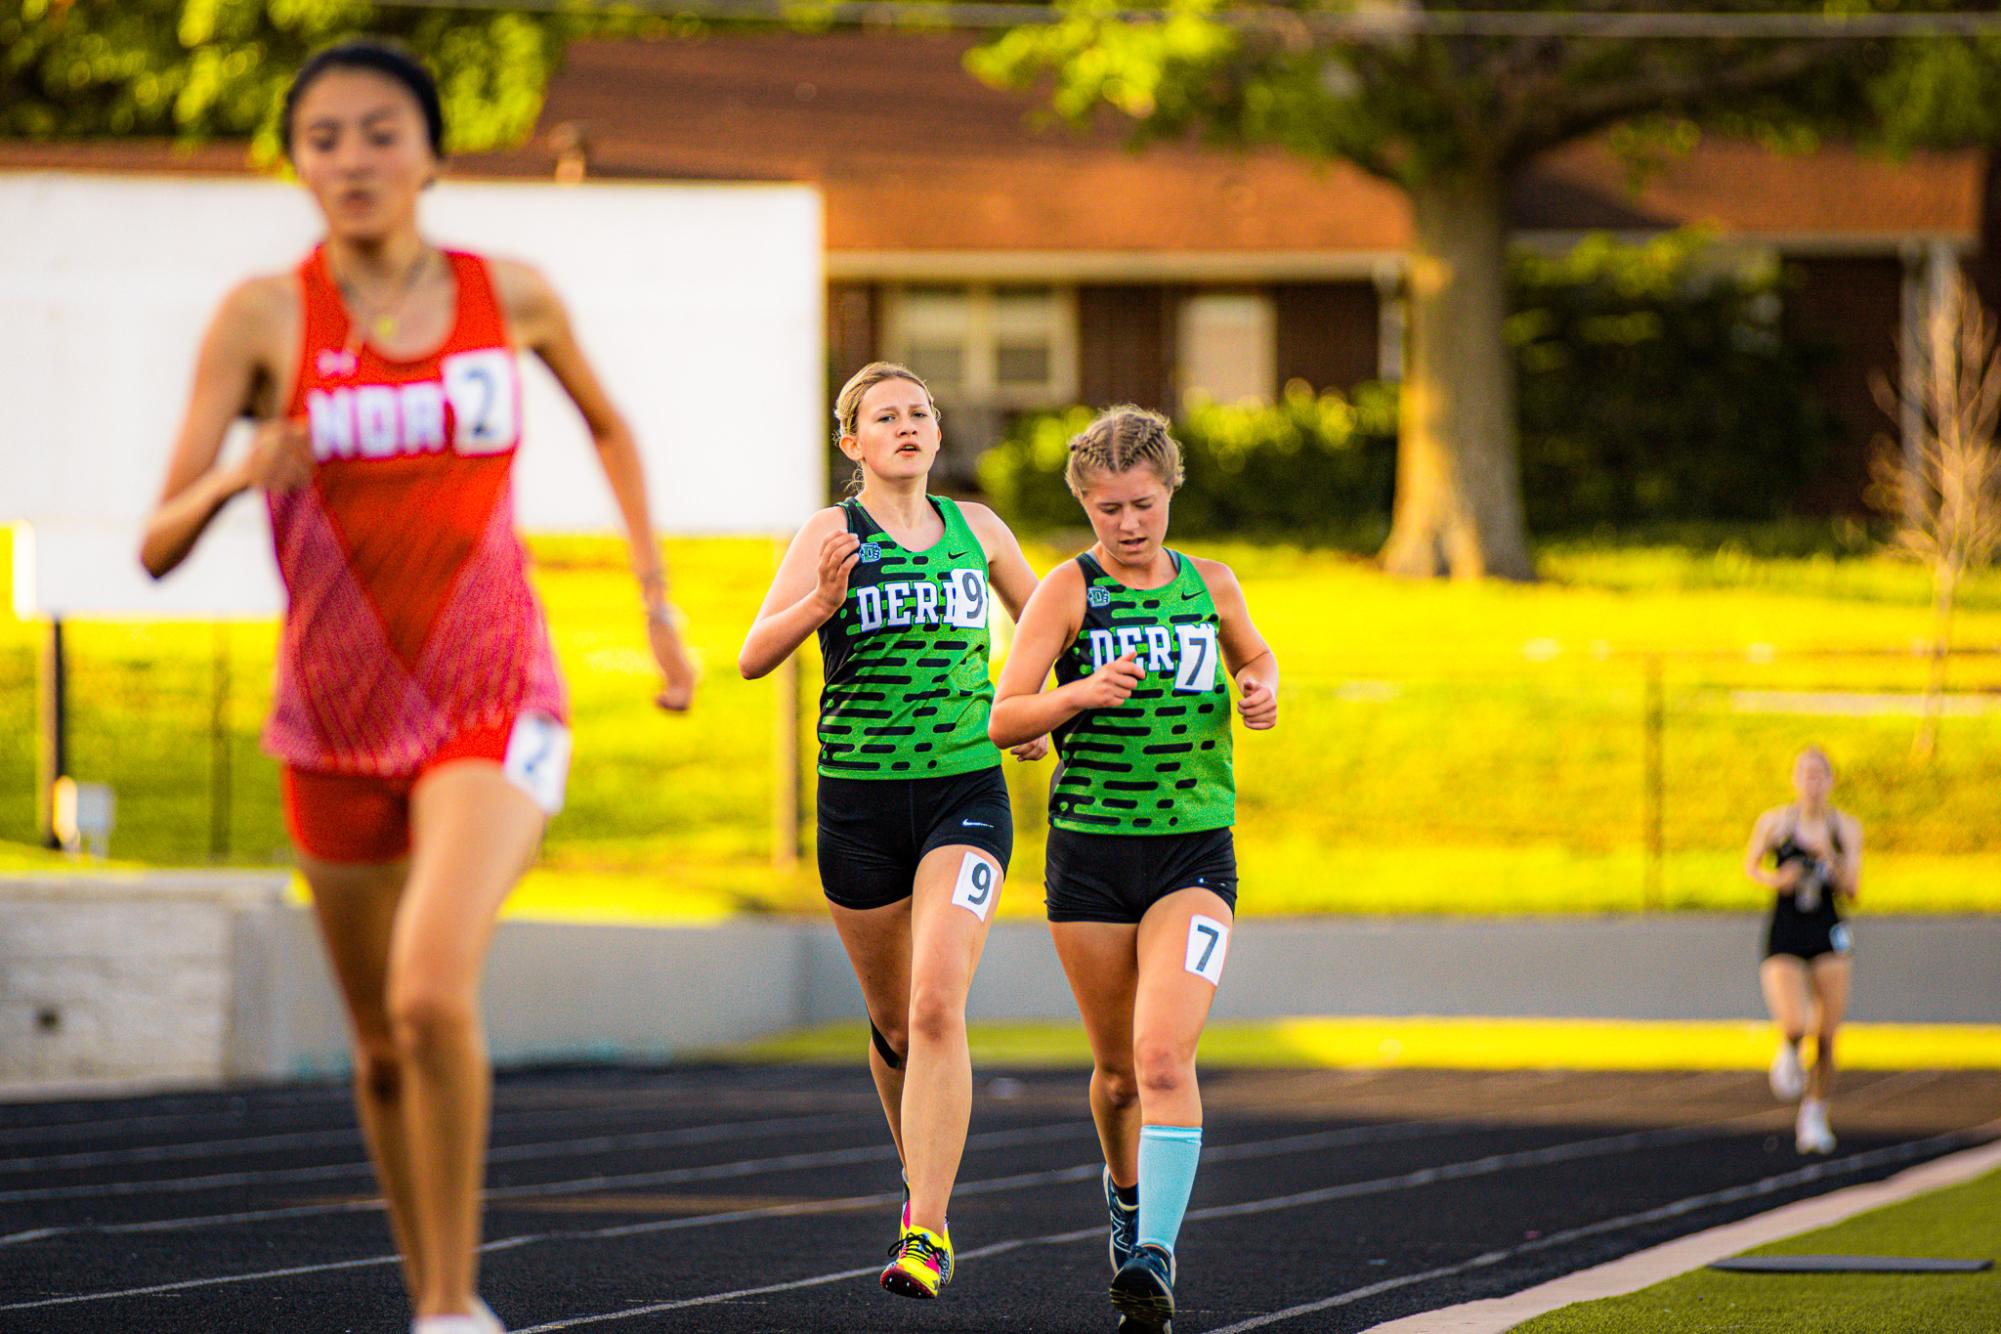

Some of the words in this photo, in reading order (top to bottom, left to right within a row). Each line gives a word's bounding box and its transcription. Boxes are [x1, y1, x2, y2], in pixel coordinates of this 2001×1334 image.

[307, 381, 446, 462] NOR
[465, 368, 500, 438] 2
[856, 581, 957, 633] DERB
[962, 572, 984, 620] 9
[1088, 625, 1182, 673] DER
[1189, 637, 1208, 686] 7
[520, 716, 553, 784] 2
[967, 862, 992, 906] 9
[1195, 924, 1220, 973] 7
